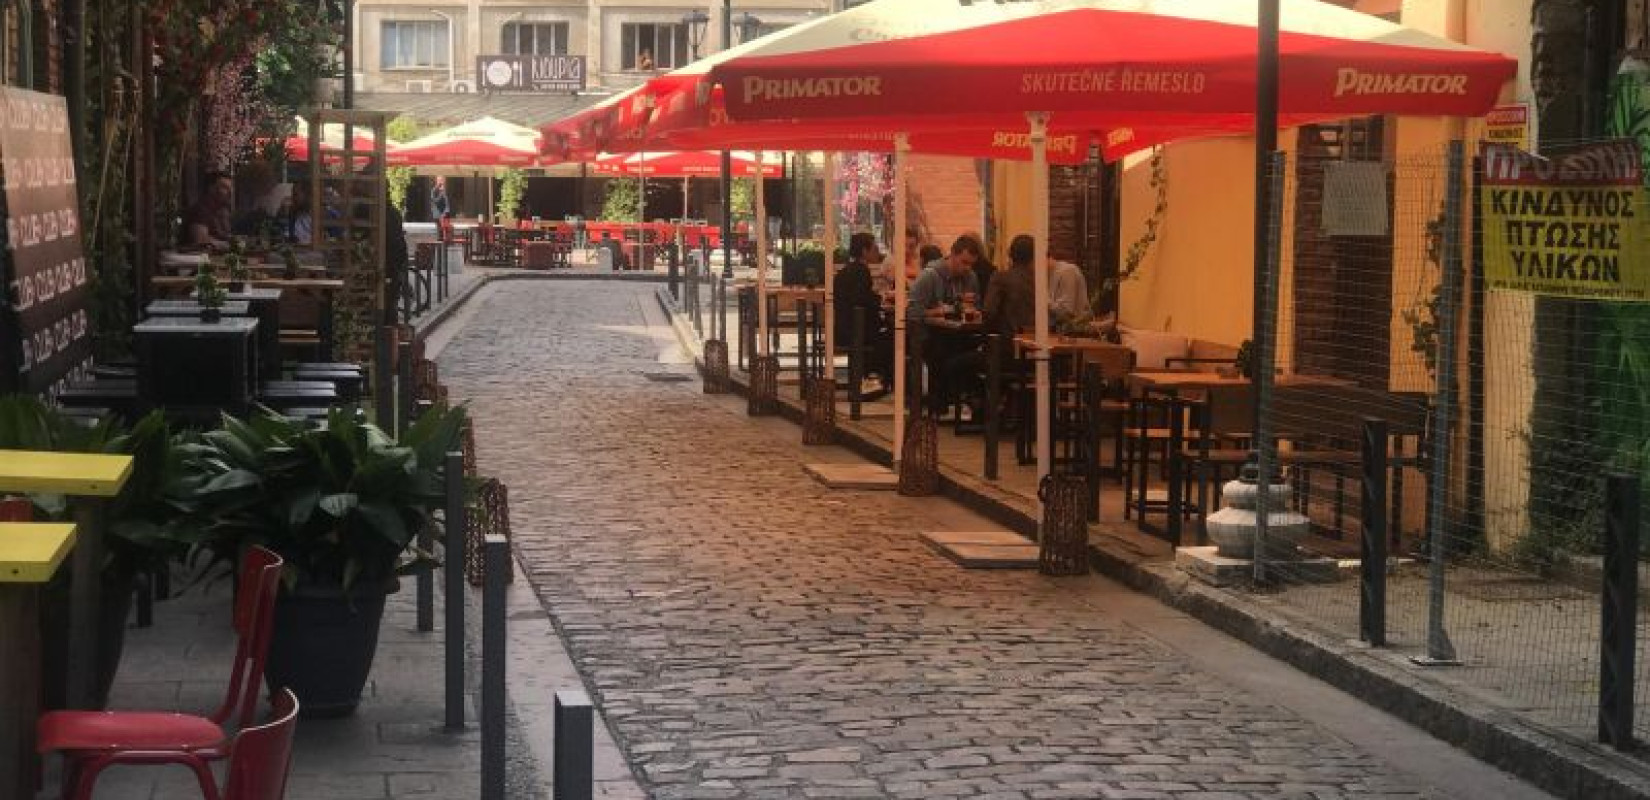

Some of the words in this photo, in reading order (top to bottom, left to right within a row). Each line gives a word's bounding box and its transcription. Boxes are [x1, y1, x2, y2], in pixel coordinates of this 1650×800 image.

[743, 76, 882, 103] PRIMATOR
[1021, 70, 1116, 94] SKUTEČNÉ
[1120, 68, 1206, 94] ŘEMESLO
[1334, 67, 1468, 97] PRIMATOR
[1491, 189, 1634, 217] ΚΙΝΔΥΝΟΣ
[1506, 220, 1621, 250] ΠΤΩΣΗΣ
[1511, 251, 1620, 282] ΥΛΙΚΩΝ
